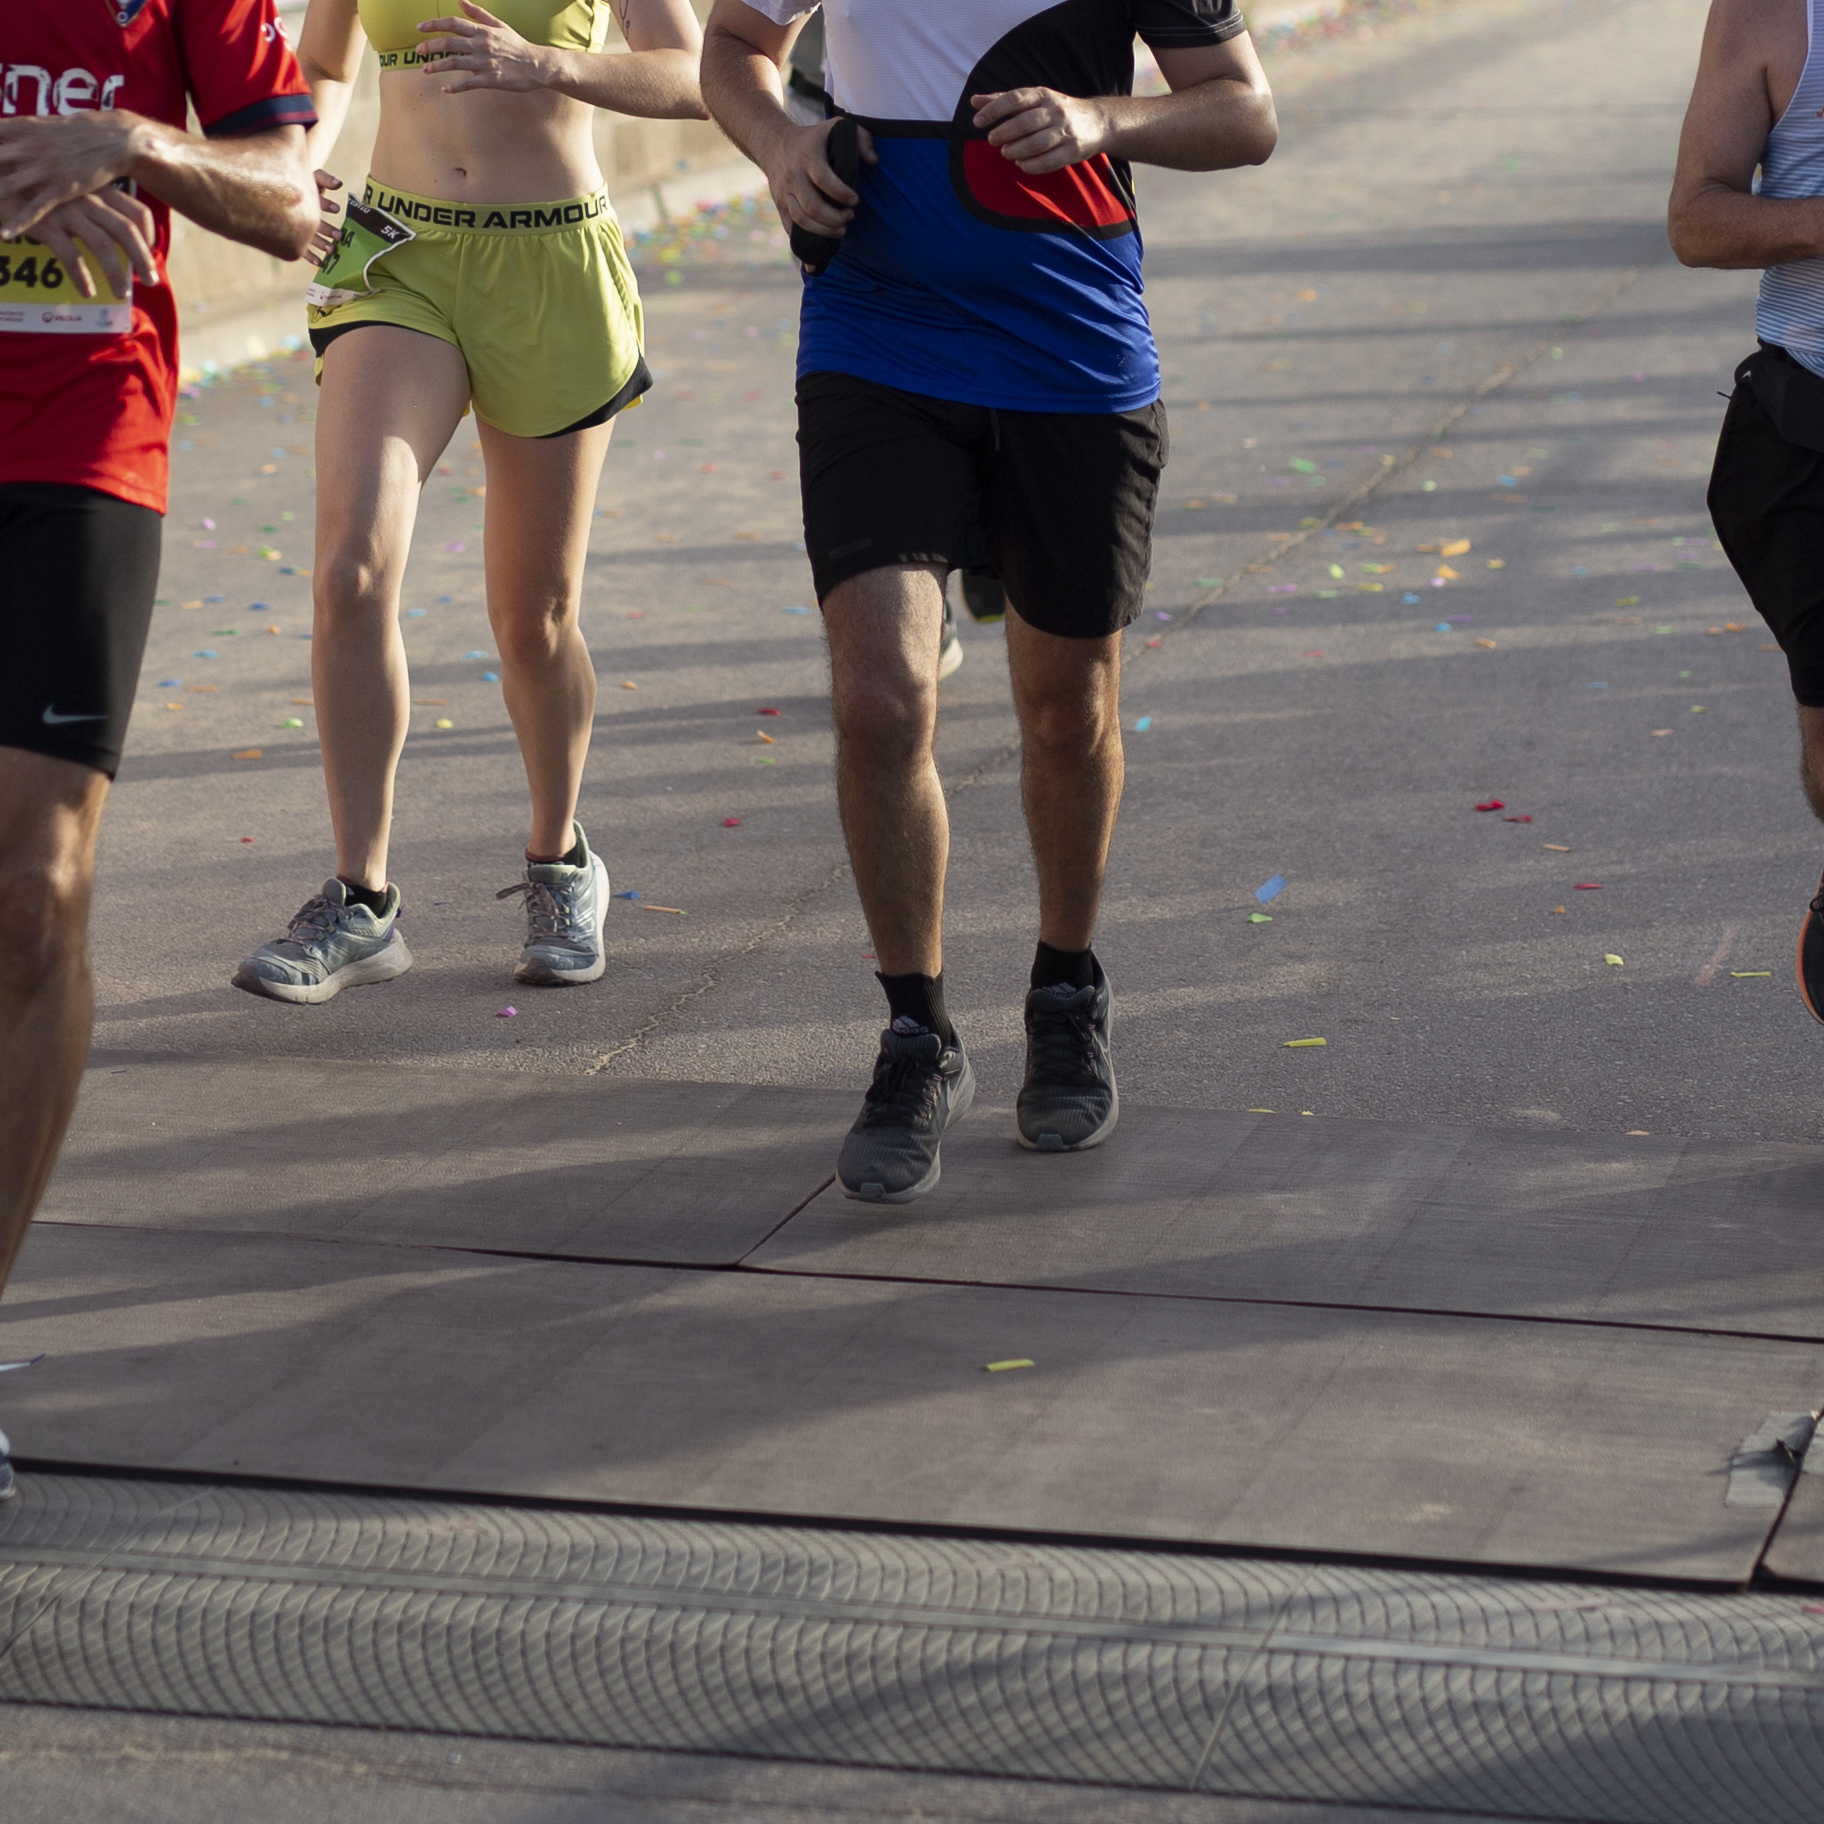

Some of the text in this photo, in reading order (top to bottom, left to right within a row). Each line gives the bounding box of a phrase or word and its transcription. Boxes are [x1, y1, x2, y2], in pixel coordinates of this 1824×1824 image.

[377, 191, 476, 229] UNDER
[482, 195, 608, 230] ARMOUR
[380, 225, 400, 240] 5K
